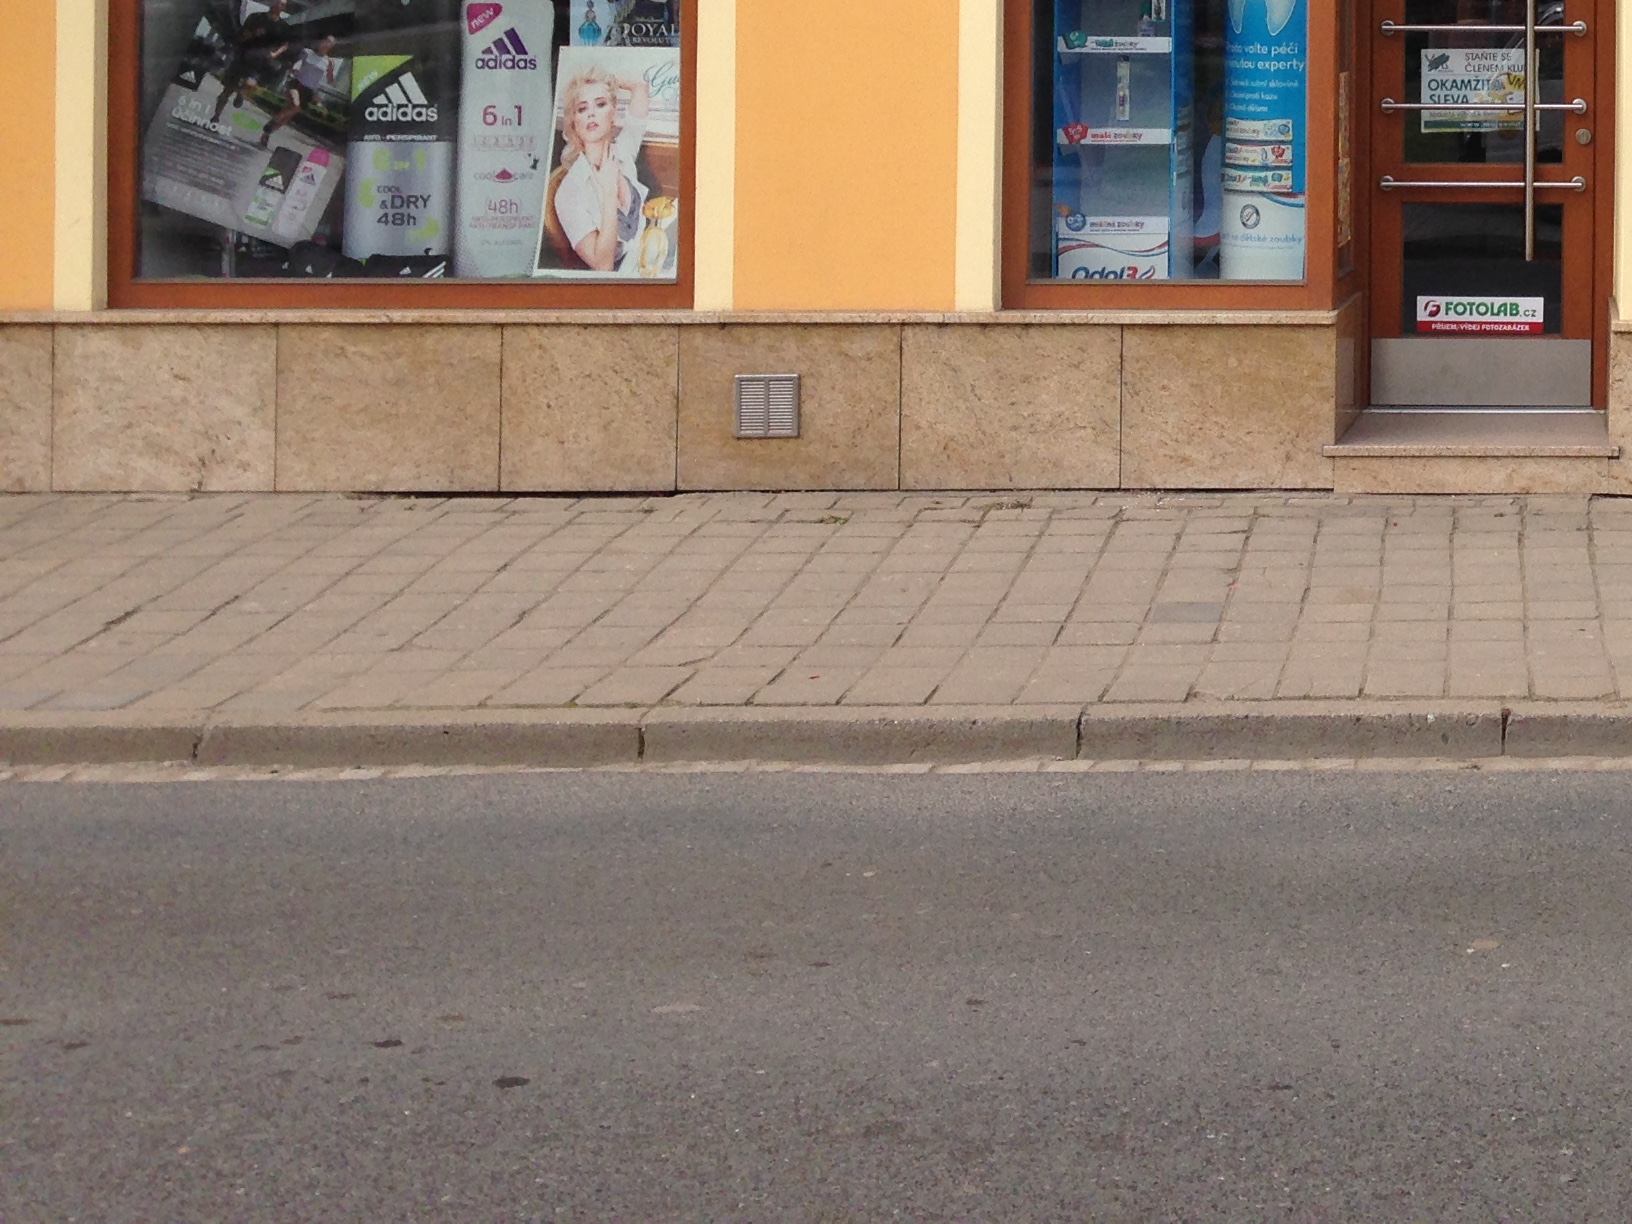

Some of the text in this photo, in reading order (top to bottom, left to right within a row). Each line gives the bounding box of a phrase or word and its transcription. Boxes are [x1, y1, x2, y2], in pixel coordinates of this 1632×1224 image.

[471, 7, 495, 29] new
[1271, 42, 1298, 57] péči
[475, 56, 537, 70] adidas
[1257, 58, 1305, 72] experty
[1507, 64, 1525, 73] KLU
[364, 104, 438, 122] adidas
[482, 105, 498, 127] 6
[514, 105, 523, 127] 1
[487, 199, 519, 215] 48h
[377, 213, 417, 227] 48h
